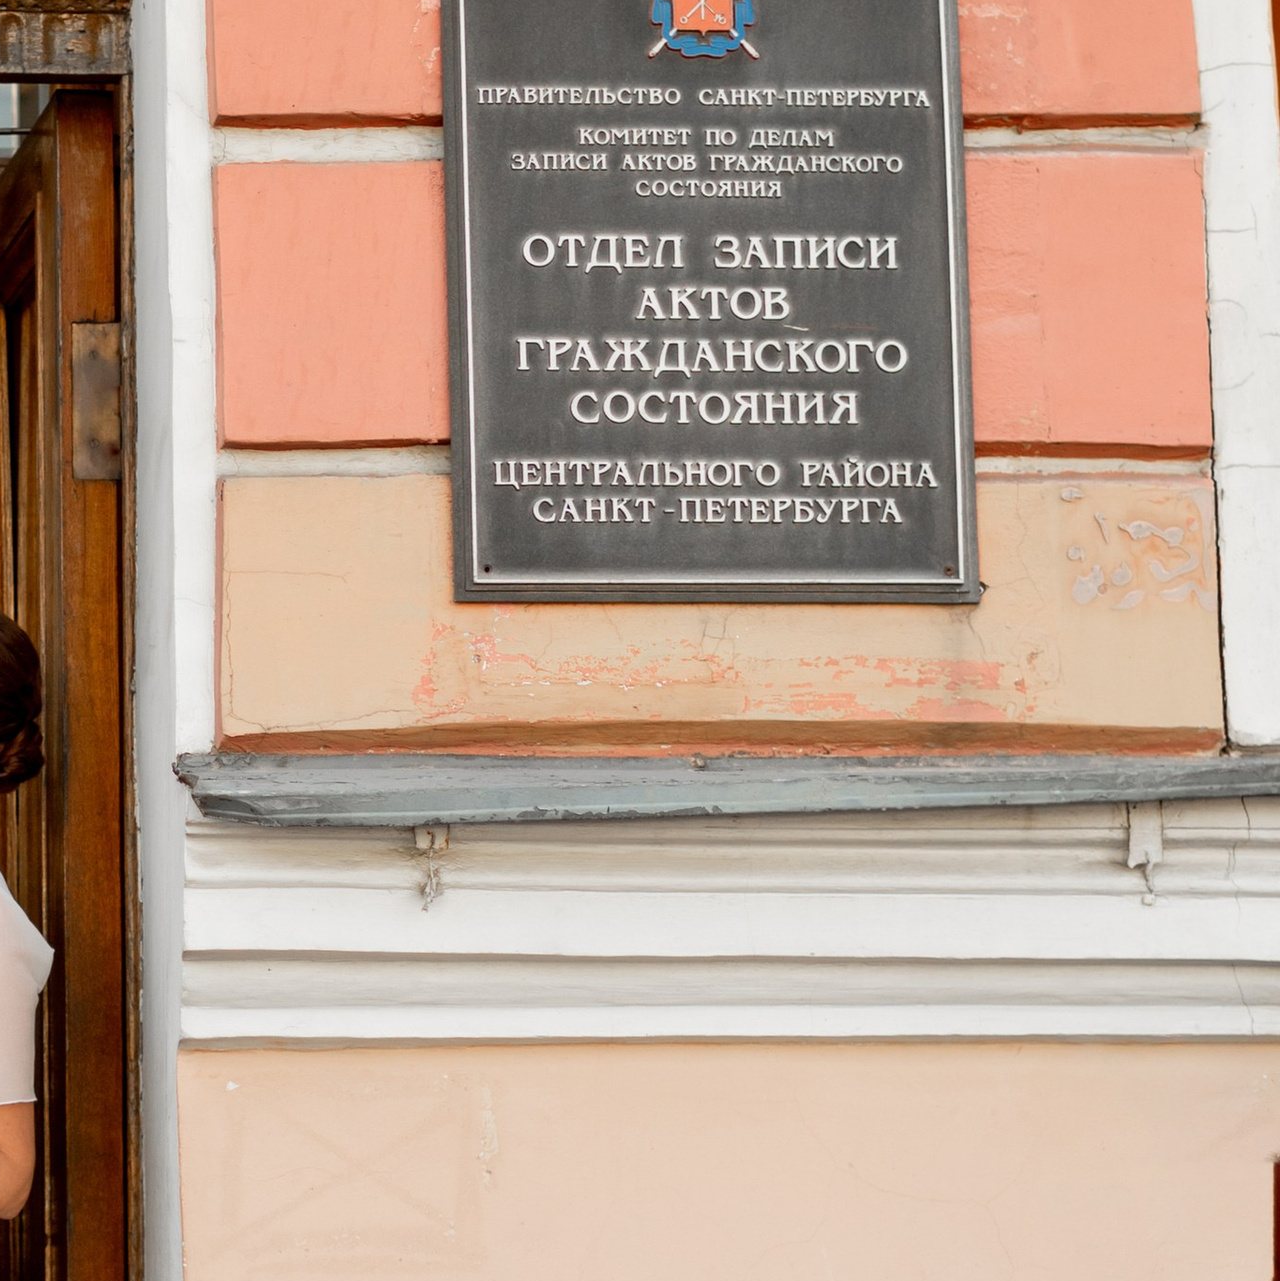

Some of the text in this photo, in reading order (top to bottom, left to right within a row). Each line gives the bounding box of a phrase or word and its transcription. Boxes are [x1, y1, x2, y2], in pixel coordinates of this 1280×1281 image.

[476, 85, 932, 108] ПРАВИТЕЛЬСТВО САНКТ-ПЕТЕРБУРГА
[578, 126, 835, 150] КОМИТЕТ ПО ДЕЛАМ
[510, 151, 904, 175] ЗАПИСИ АКТОВ ГРАЖДАНСКОГО
[635, 178, 783, 199] СОСТОЯНИЯ
[521, 232, 899, 274] ОТДЕЛ ЗАПИСИ
[634, 285, 791, 320] АКТОВ
[515, 336, 909, 378] ГРАЖДАНСКОГО
[569, 389, 860, 425] СОСТОЯНИЯ
[493, 455, 939, 490] ЦЕНТРАЛЬНОГО РАЙОНА
